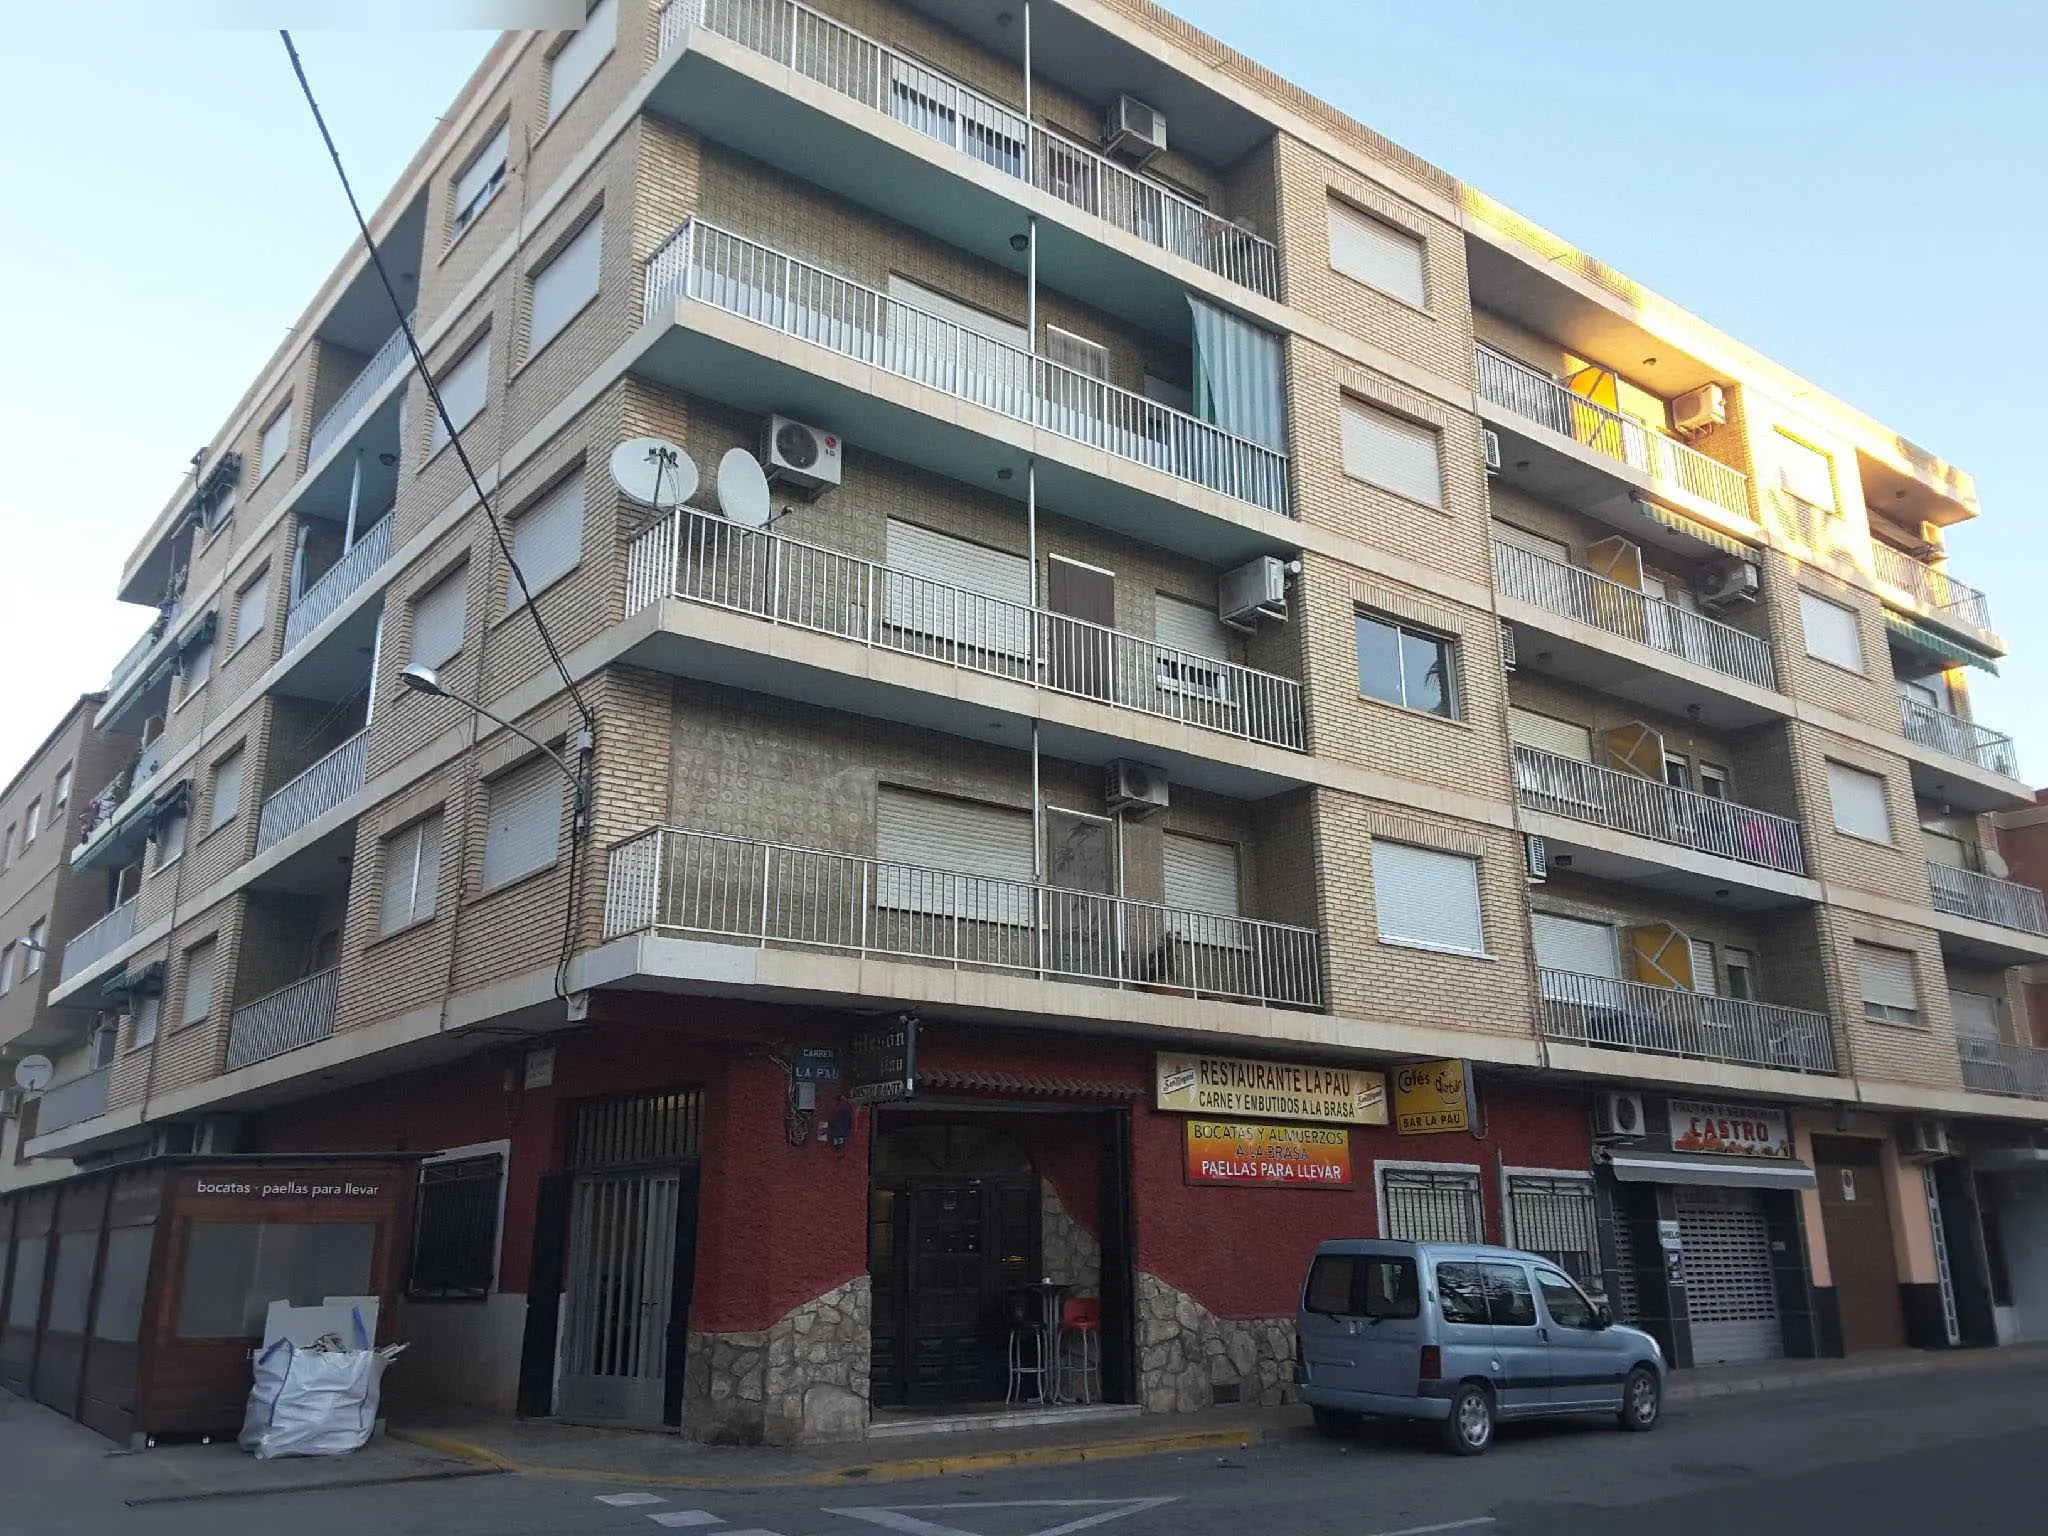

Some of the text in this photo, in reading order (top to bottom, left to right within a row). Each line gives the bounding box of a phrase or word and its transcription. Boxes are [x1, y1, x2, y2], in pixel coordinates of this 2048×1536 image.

[795, 1066, 812, 1078] LA
[816, 1067, 840, 1080] PAU
[1199, 1060, 1350, 1097] RESTAURANTE LA PAU
[1199, 1091, 1355, 1118] CARNE Y EMBUTIDOS A LA BRASA
[1403, 1113, 1460, 1128] BAR LA PAU
[1690, 1117, 1769, 1142] CASTRO
[1194, 1124, 1344, 1145] BOCATAS Y ALMUERZOS
[1235, 1144, 1309, 1161] A LA BRASA
[1201, 1160, 1341, 1179] PAELLAS PARA LLEVAR
[197, 1180, 380, 1198] bocatas paellas para llevar
